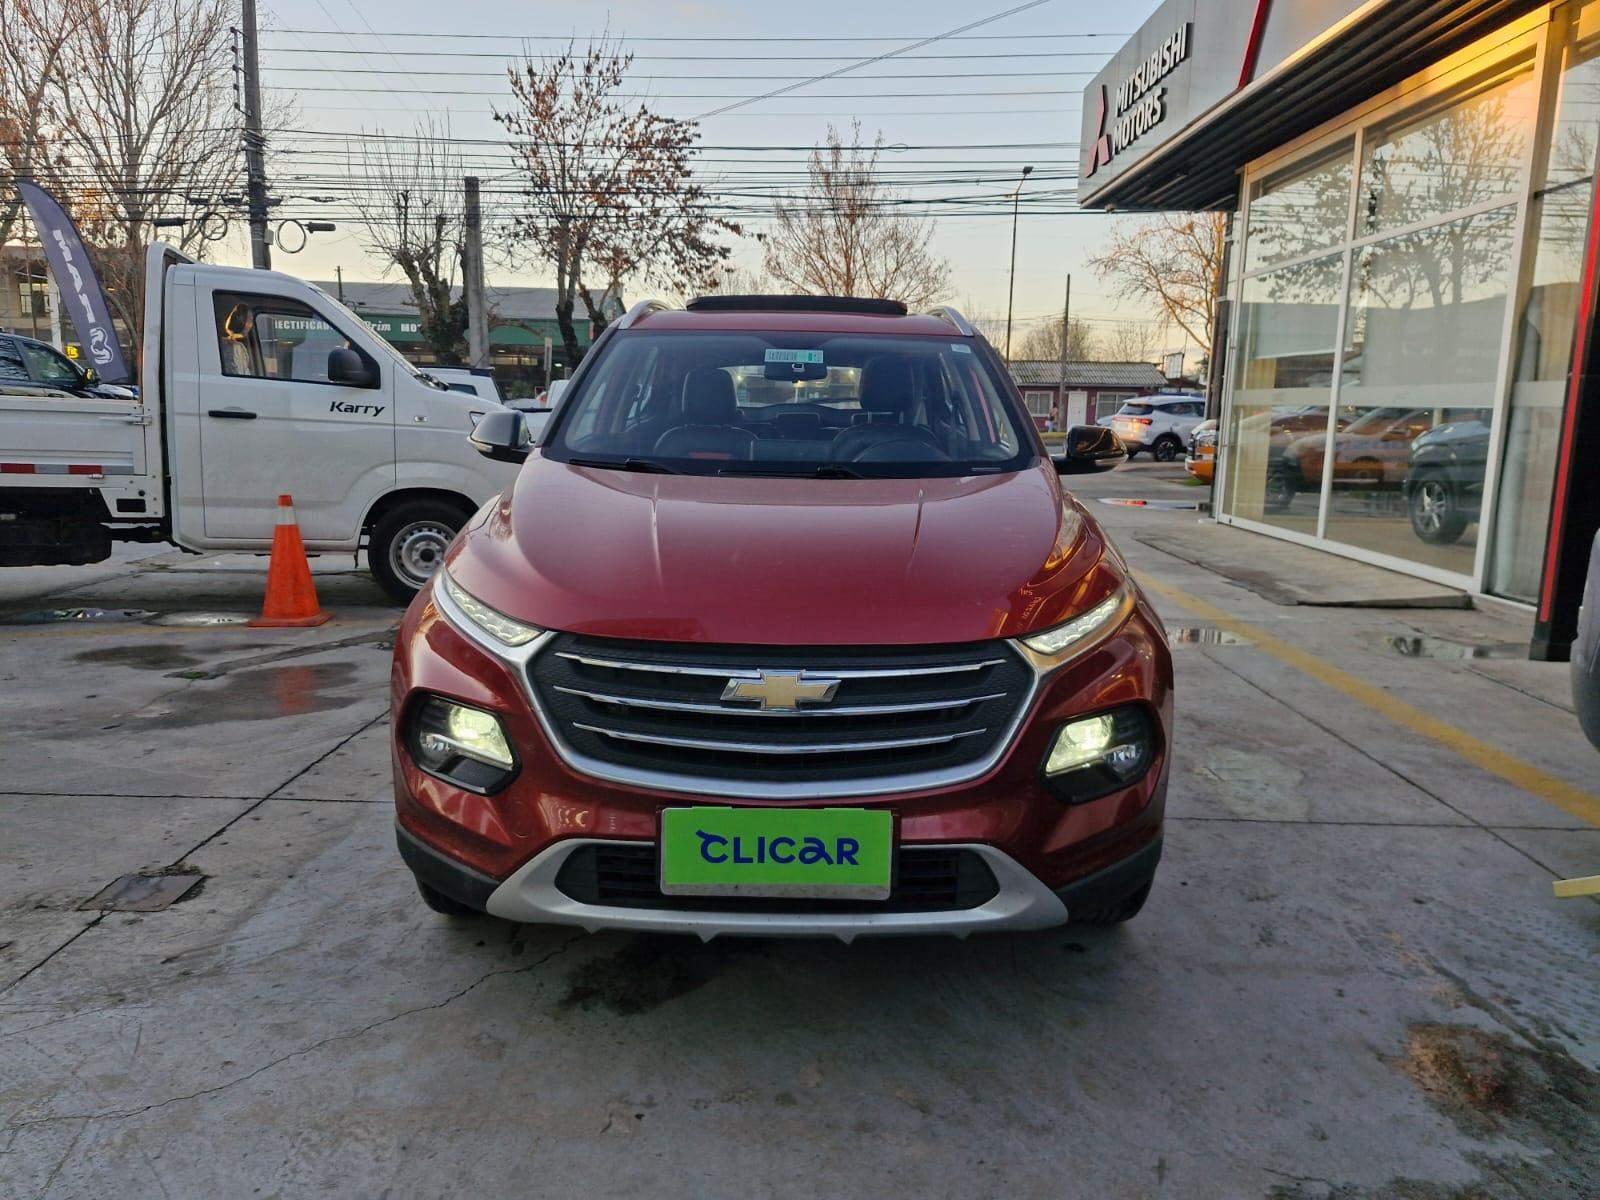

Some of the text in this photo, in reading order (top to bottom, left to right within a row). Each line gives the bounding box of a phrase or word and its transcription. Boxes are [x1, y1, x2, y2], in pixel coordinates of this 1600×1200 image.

[1116, 22, 1191, 117] MITSUBISHI
[1112, 87, 1166, 155] MOTORS
[329, 401, 386, 417] Karry
